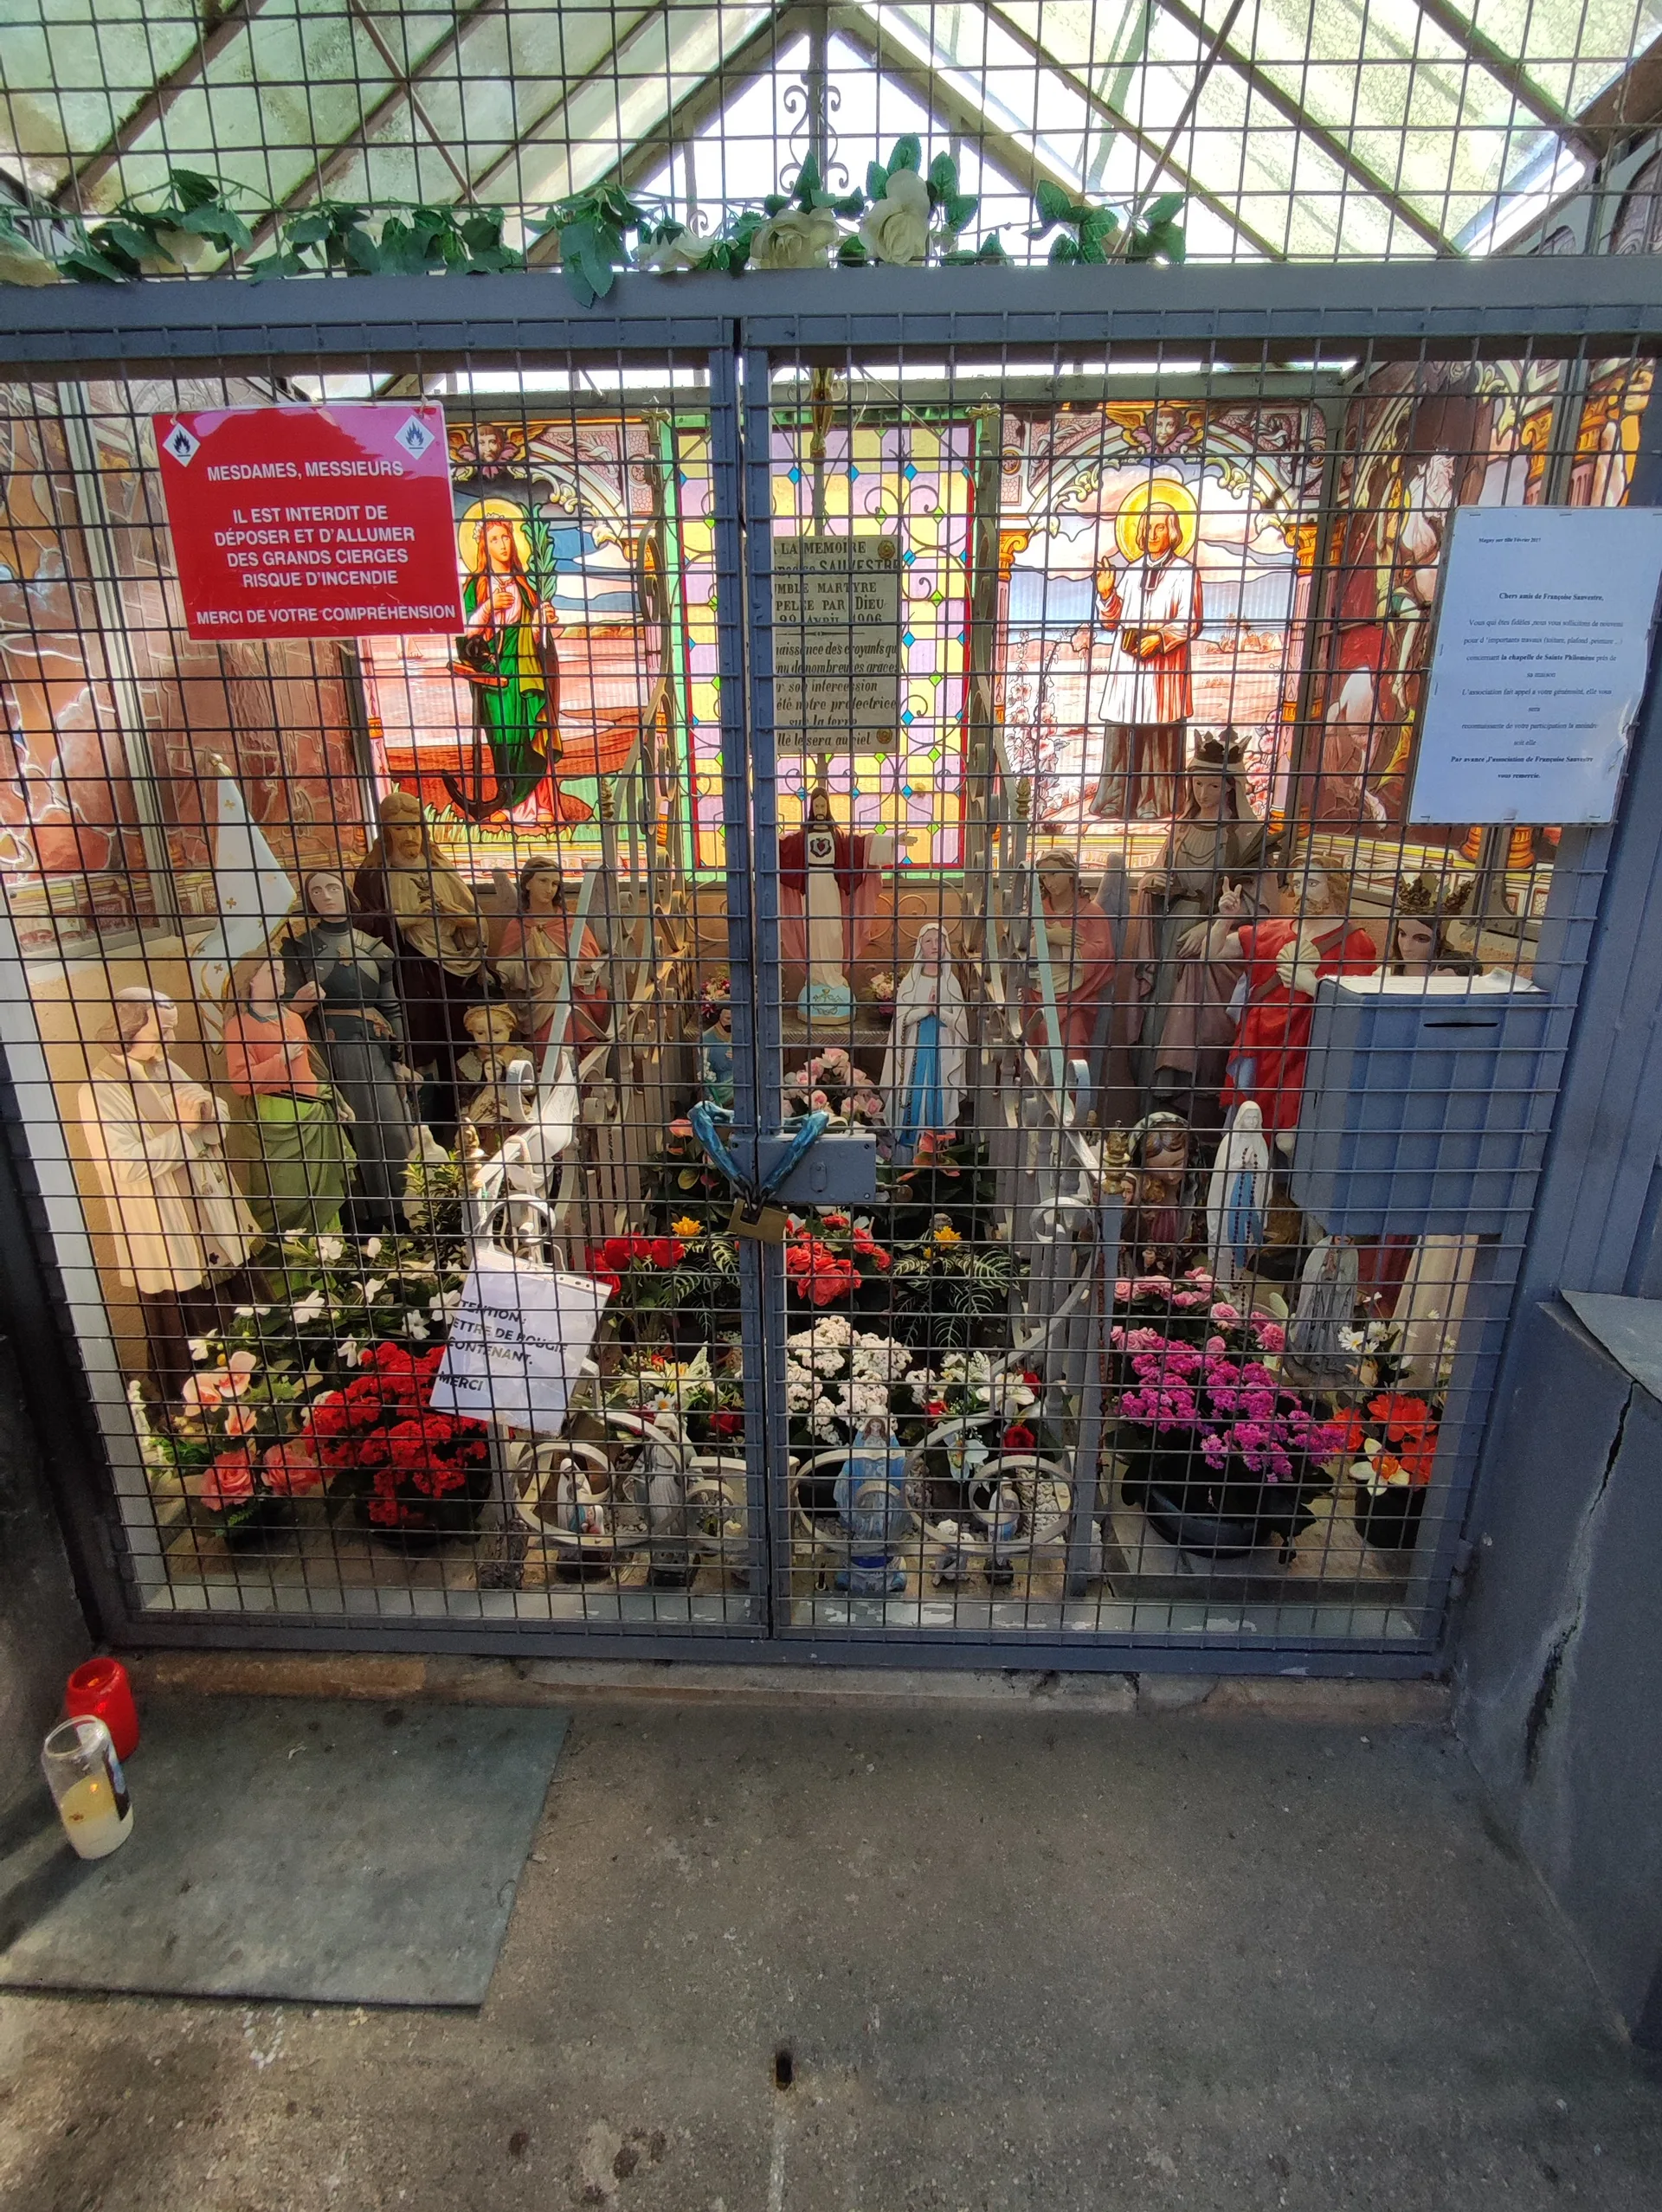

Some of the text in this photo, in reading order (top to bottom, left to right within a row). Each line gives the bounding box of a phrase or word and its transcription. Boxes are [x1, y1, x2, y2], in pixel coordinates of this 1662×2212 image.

[207, 460, 403, 481] MESDAMES, MESSIEURS
[233, 505, 388, 524] IL EST INTERDIT DE
[215, 526, 415, 546] DÉPOSER ET D'ALLUMER
[782, 543, 798, 555] LA
[228, 548, 409, 567] DES GRANDS CIERGES
[820, 559, 899, 574] SAUESTRE
[242, 569, 398, 588] RISQUE D'INCENDIE
[817, 582, 877, 594] MARTYRE
[1543, 593, 1571, 601] Françoise
[196, 603, 456, 624] MERCI DE VOTRE COMPRÉHENSION
[822, 600, 846, 611] PAR
[825, 642, 842, 655] des
[886, 645, 898, 658] qu
[805, 659, 864, 674] nombreues
[776, 698, 792, 711] été
[807, 736, 831, 747] sera
[850, 732, 871, 746] iel
[453, 1318, 493, 1335] ETTRE
[495, 1328, 513, 1340] DE
[439, 1371, 483, 1392] MERCI
